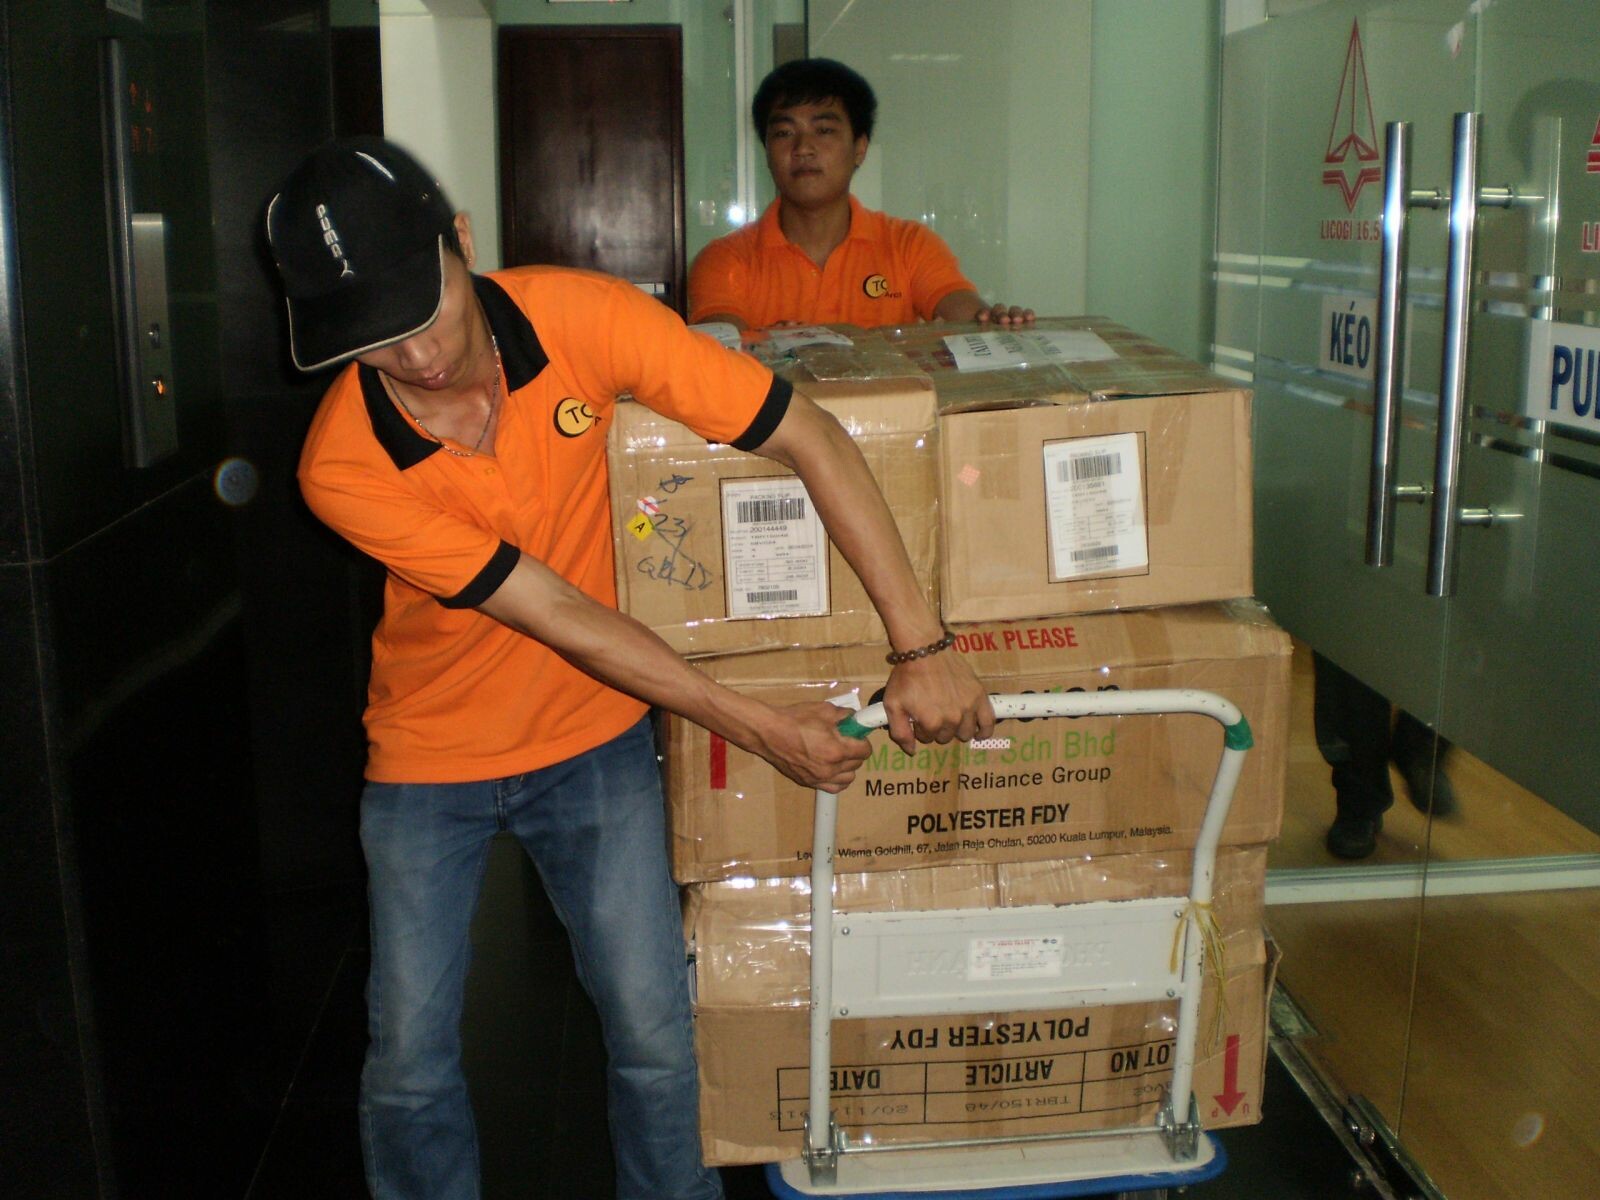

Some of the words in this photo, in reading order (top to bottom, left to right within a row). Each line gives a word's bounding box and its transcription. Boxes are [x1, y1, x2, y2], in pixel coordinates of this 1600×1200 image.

[1320, 218, 1353, 241] LICOGI
[1356, 219, 1381, 241] 16.5
[1329, 300, 1371, 369] KÉO
[1002, 626, 1079, 650] PLEASE
[1000, 735, 1053, 765] Sdn
[1064, 729, 1117, 759] Bhd
[865, 777, 950, 797] Member
[957, 771, 1043, 790] Reliance
[1052, 766, 1112, 784] Group
[907, 806, 1025, 835] POLYESTER
[1031, 803, 1070, 825] FDY
[874, 844, 914, 856] Goldhill,
[916, 843, 932, 854] 67,
[987, 837, 1024, 849] Chulan,
[1027, 833, 1057, 845] 50200
[1059, 831, 1087, 843] Kuala
[1089, 828, 1127, 841] Lumpur,
[890, 1027, 938, 1050] FDY
[948, 1016, 1090, 1047] POLYESTER
[1110, 1050, 1139, 1073] NO
[1143, 1042, 1176, 1067] OT
[830, 1069, 881, 1090] DATE
[965, 1059, 1054, 1086] ARTICLE
